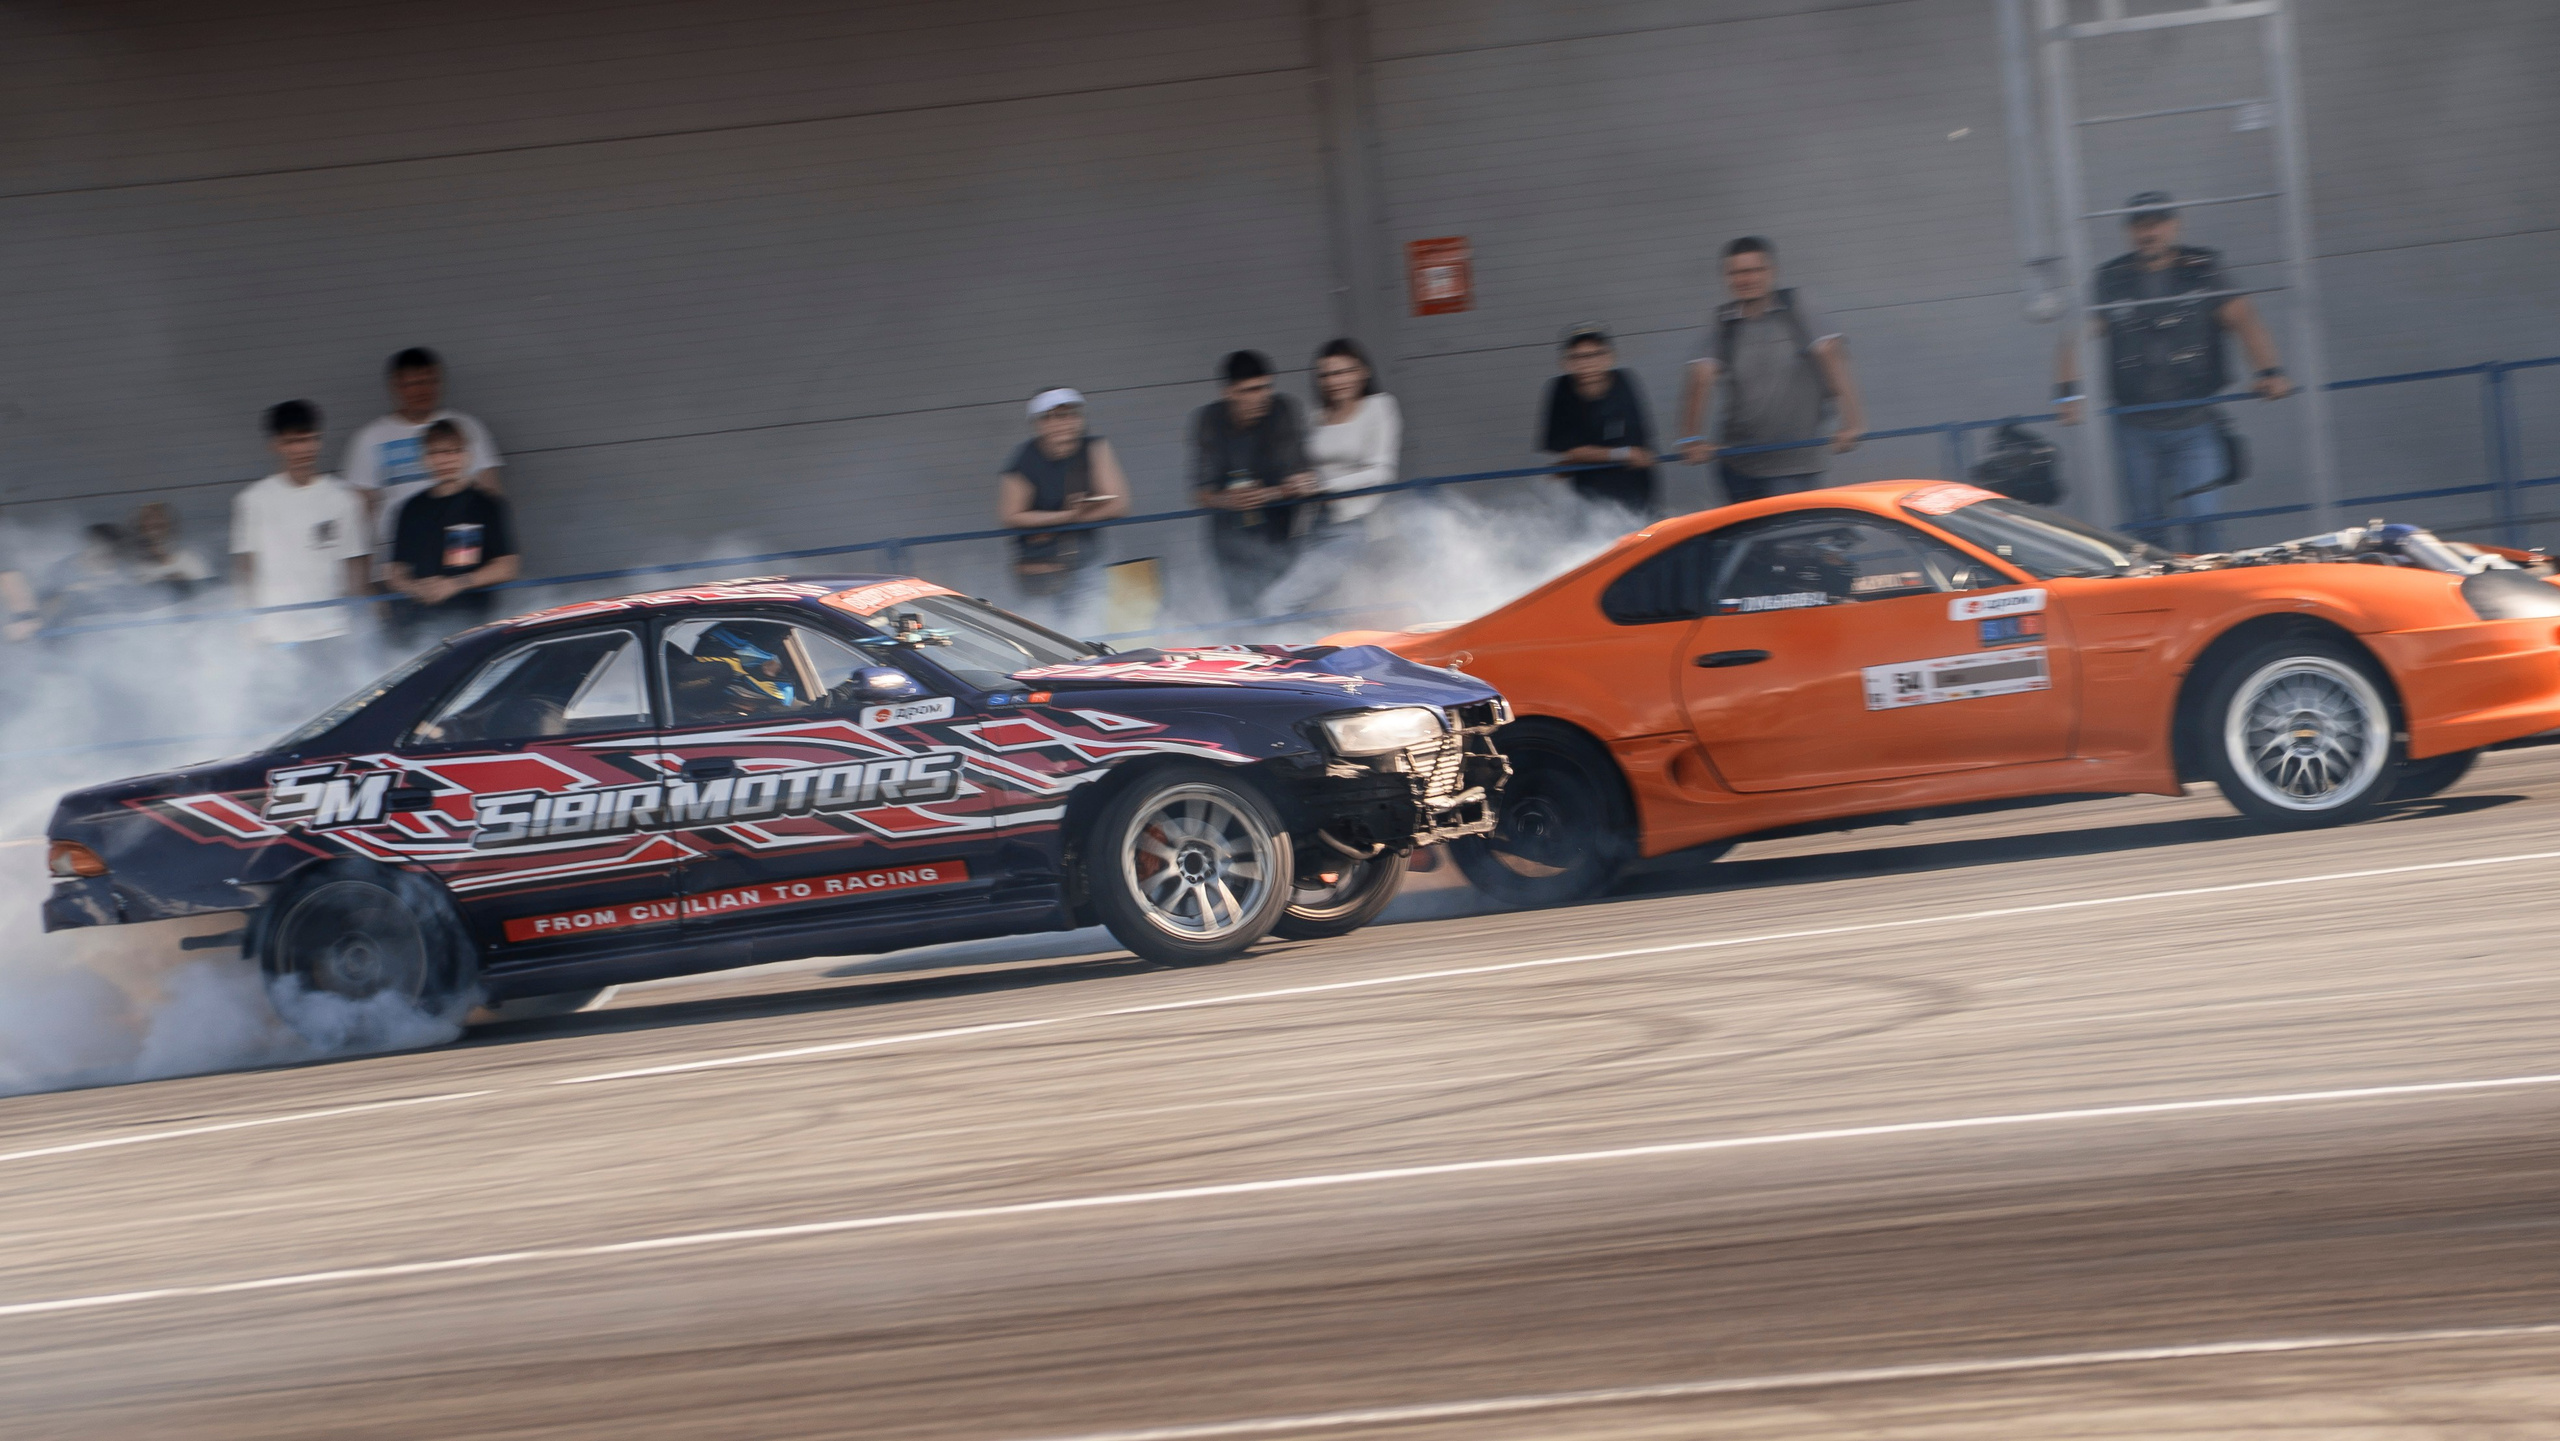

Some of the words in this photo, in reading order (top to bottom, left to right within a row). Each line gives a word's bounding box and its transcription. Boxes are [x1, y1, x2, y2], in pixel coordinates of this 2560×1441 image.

[266, 764, 395, 827] SM
[474, 785, 664, 845] SIBIR
[664, 754, 957, 823] MOTORS
[535, 910, 617, 933] FROM
[629, 890, 761, 920] CIVILIAN
[772, 883, 812, 899] TO
[824, 868, 939, 893] RACING
